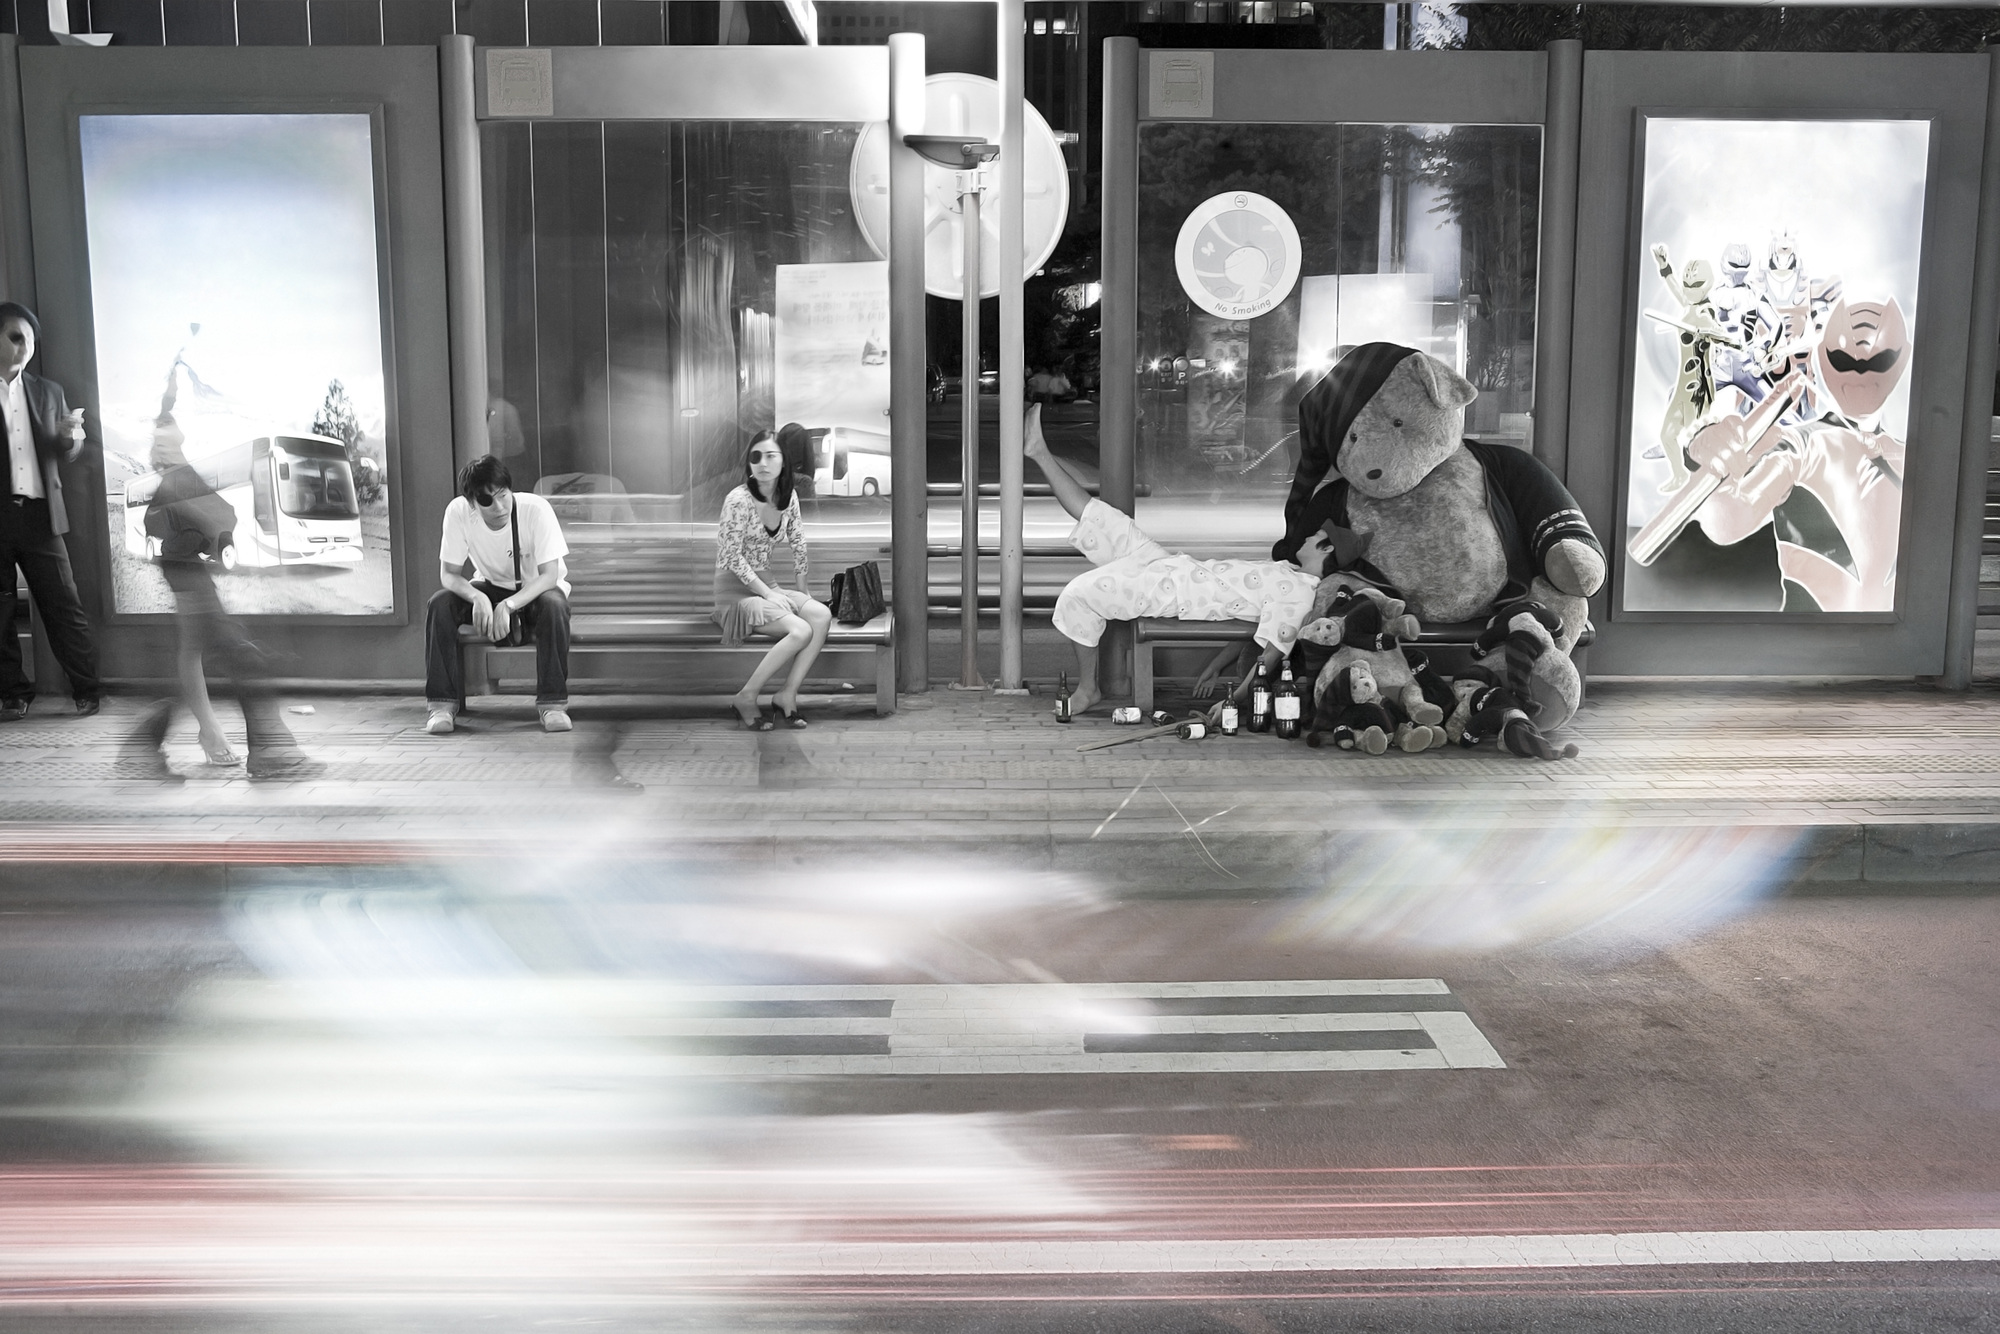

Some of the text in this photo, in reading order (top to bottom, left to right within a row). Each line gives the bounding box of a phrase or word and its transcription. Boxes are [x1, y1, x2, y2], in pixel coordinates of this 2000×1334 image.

[1214, 298, 1272, 315] No Smoking
[1178, 372, 1186, 380] P
